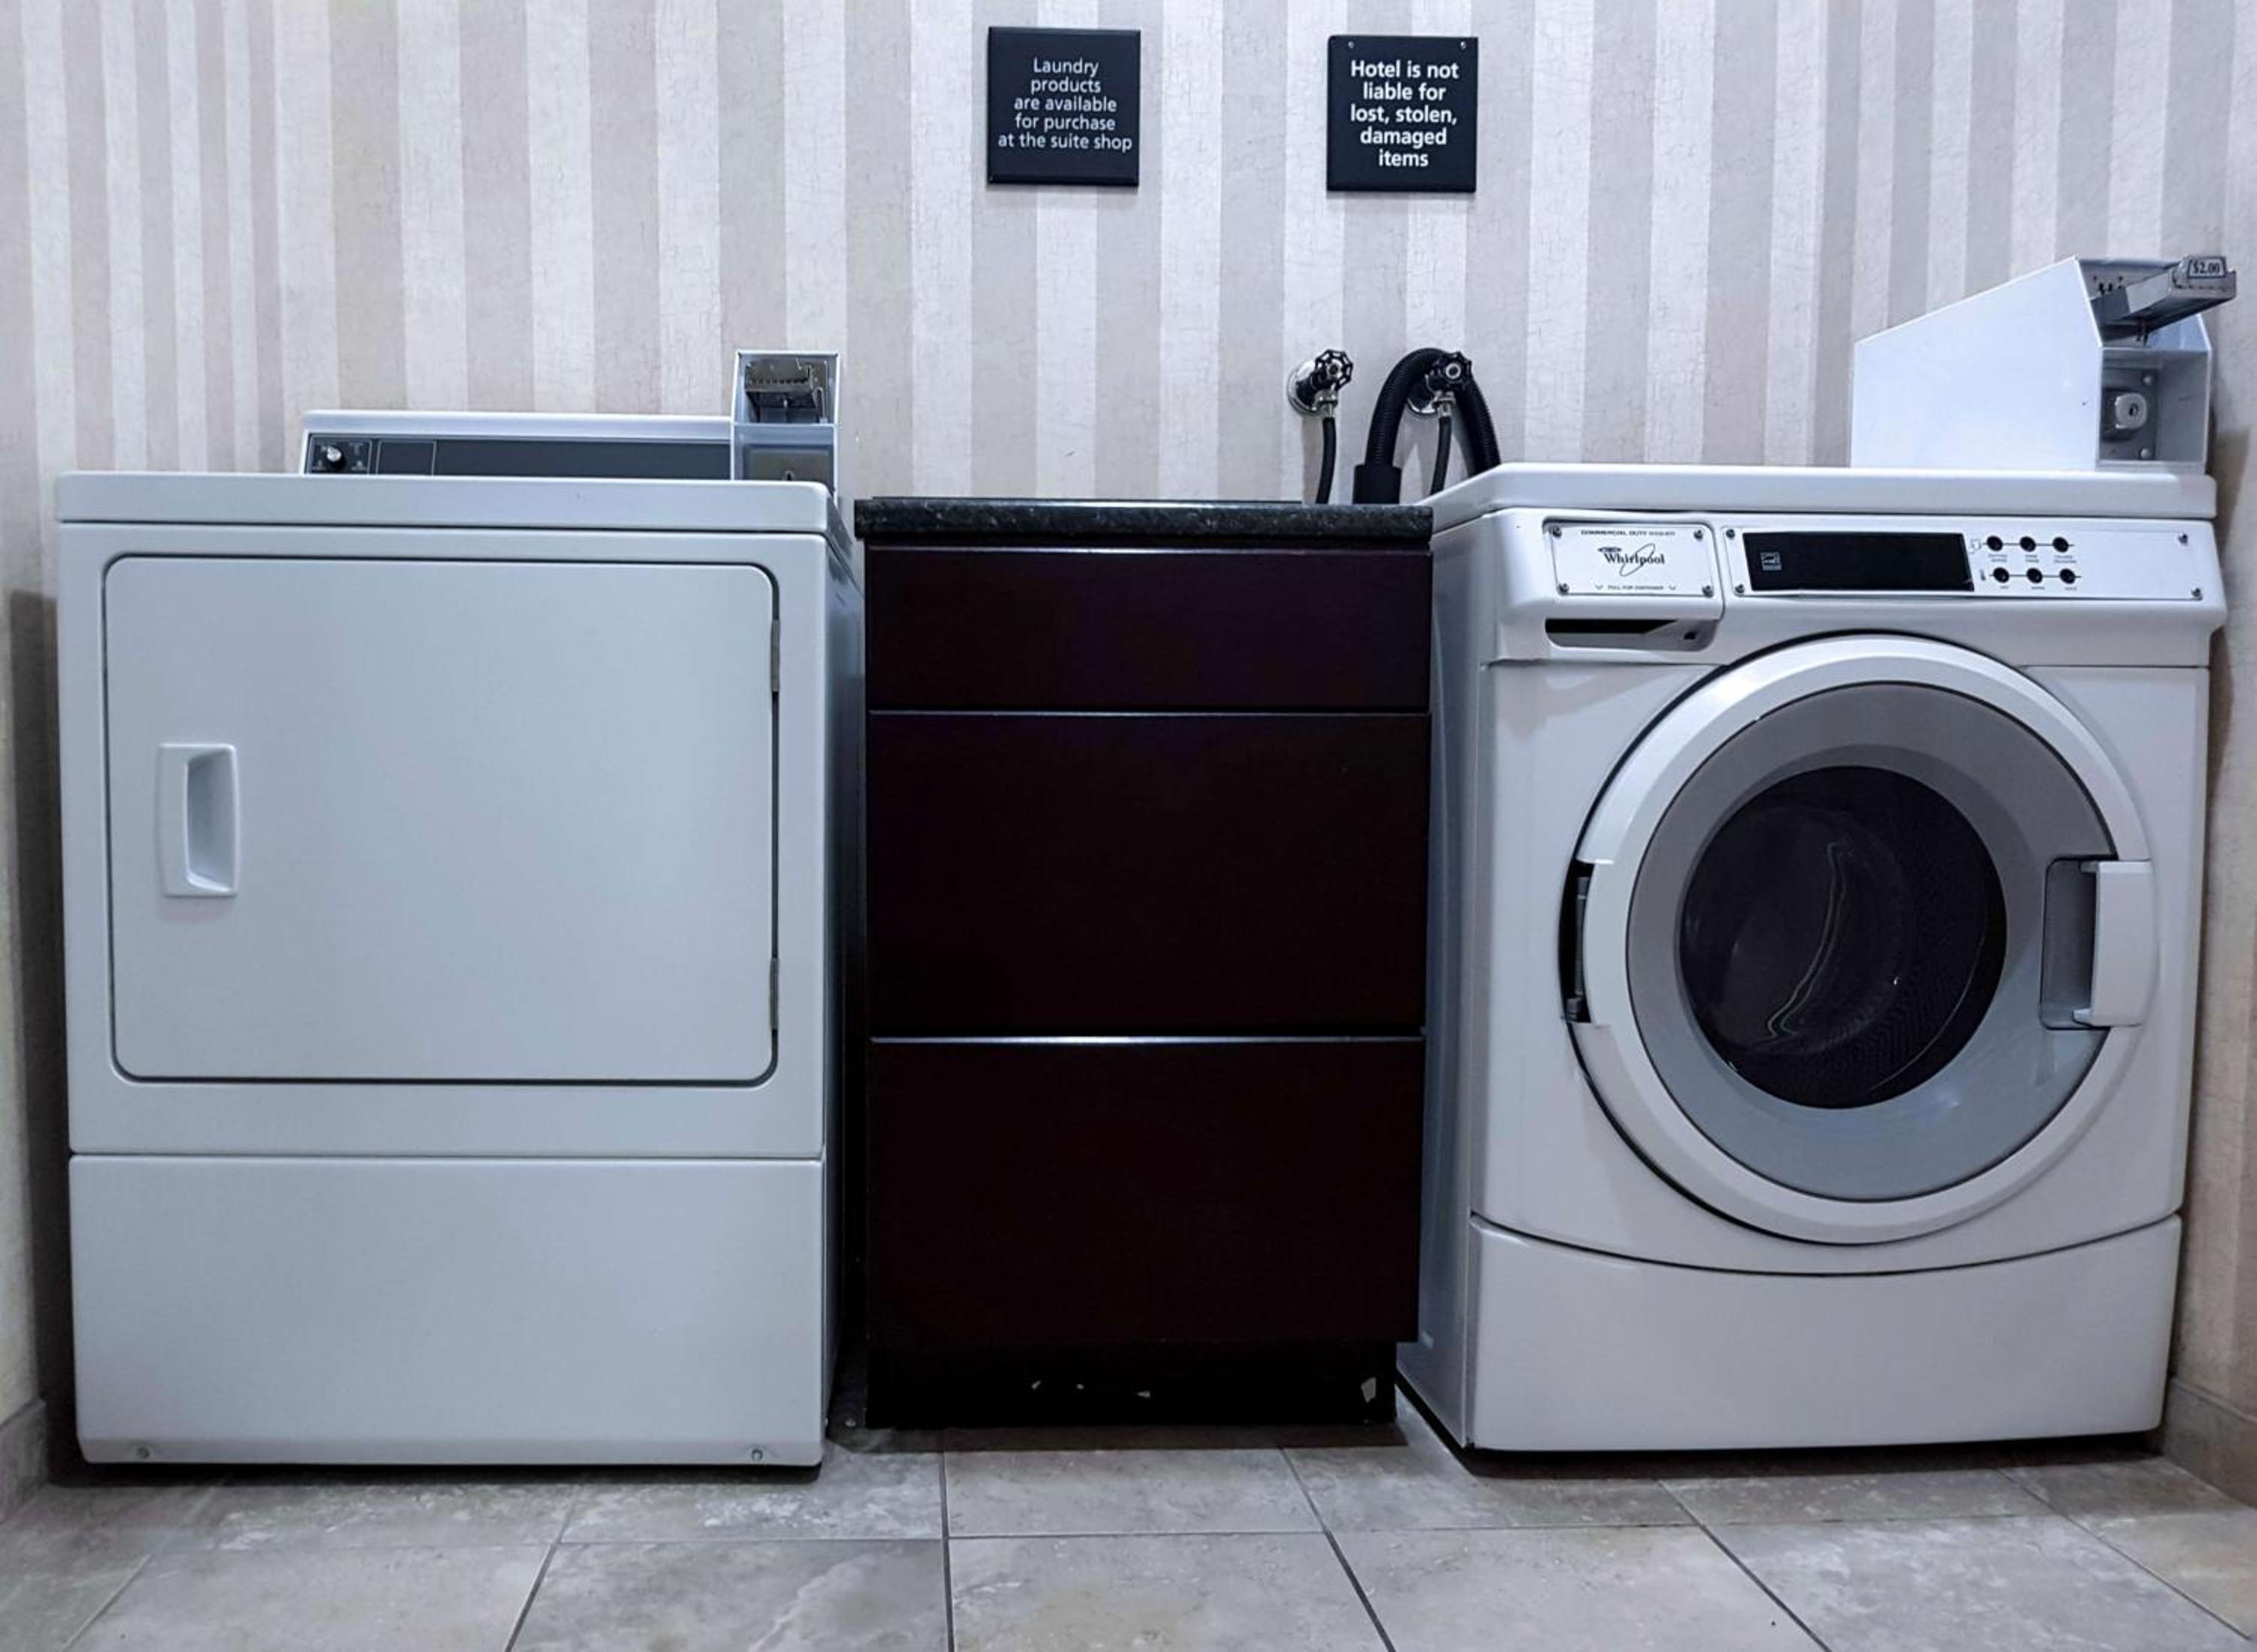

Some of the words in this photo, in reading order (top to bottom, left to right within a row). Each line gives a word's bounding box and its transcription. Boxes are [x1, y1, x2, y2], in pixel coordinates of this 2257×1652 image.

[1033, 57, 1099, 77] Laundry
[1350, 59, 1400, 77] Hotel
[1407, 60, 1421, 77] is
[1427, 62, 1460, 79] not
[1031, 77, 1101, 94] products
[1363, 81, 1413, 100] liable
[1418, 82, 1446, 101] for
[1014, 97, 1040, 110] are
[1045, 96, 1117, 112] available
[1015, 112, 1038, 129] for
[1043, 114, 1116, 132] purchase
[1350, 103, 1390, 124] lost,
[1396, 105, 1457, 126] stolen,
[998, 133, 1015, 147] at
[1019, 132, 1046, 147] the
[1051, 133, 1089, 149] suite
[1094, 134, 1132, 153] shop
[1360, 126, 1447, 149] damaged
[1378, 148, 1429, 167] items
[1603, 553, 1665, 566] Whirlpool
